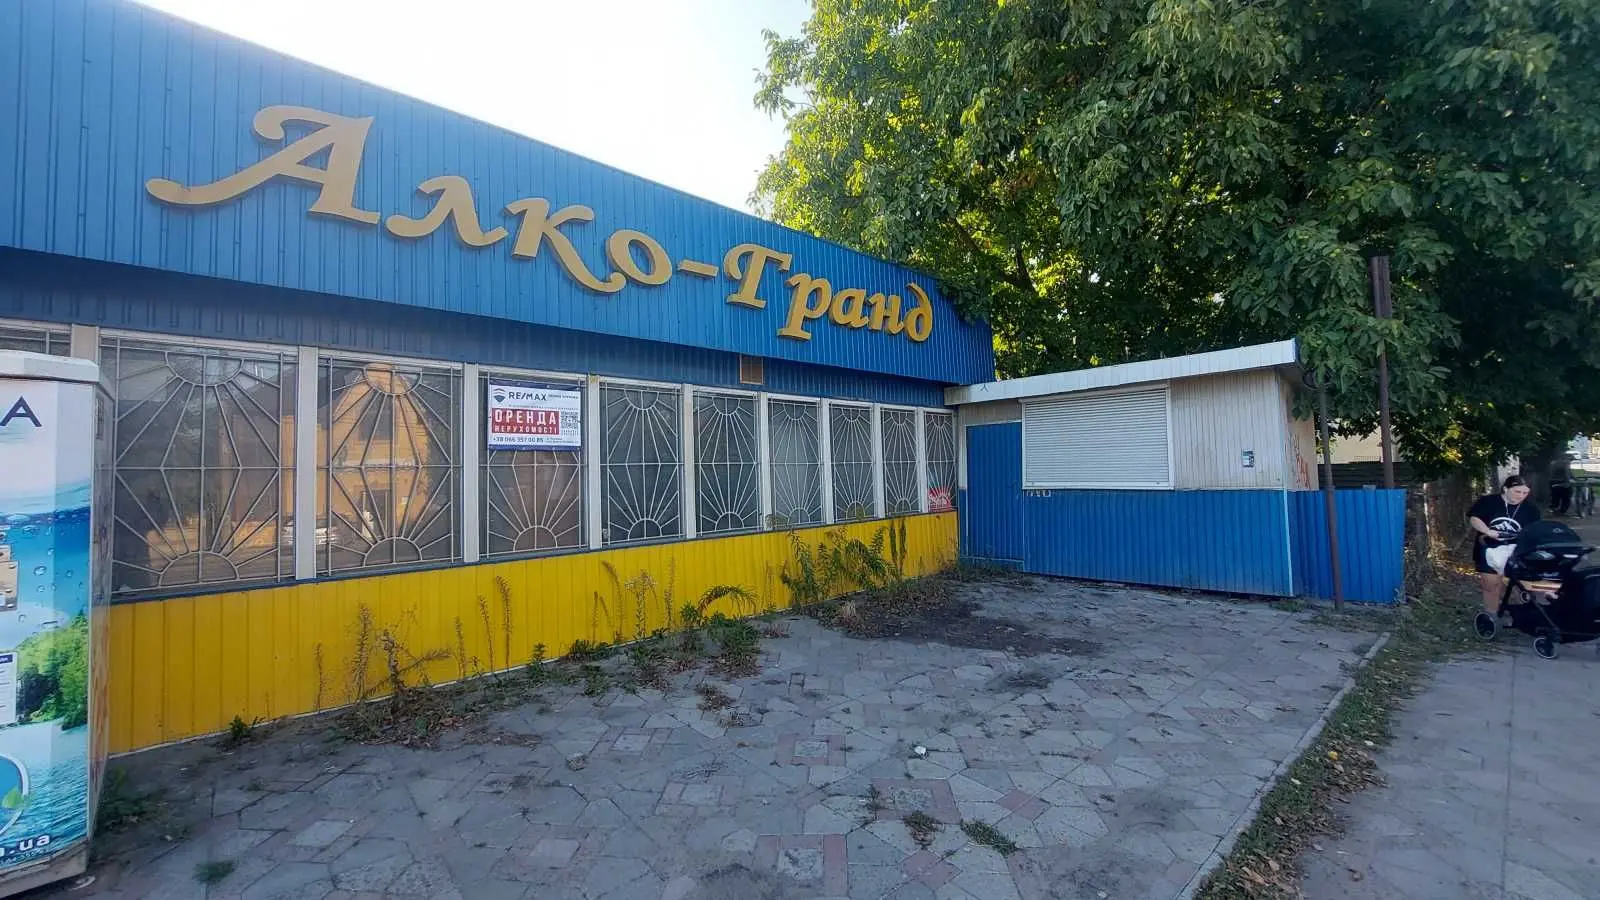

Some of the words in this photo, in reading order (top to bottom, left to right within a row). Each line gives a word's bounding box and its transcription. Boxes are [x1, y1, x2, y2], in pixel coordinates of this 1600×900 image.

[508, 391, 547, 401] RE/MAX
[494, 409, 557, 425] ОРЕНДА
[494, 425, 557, 434] НЕРУХОМОСТІ
